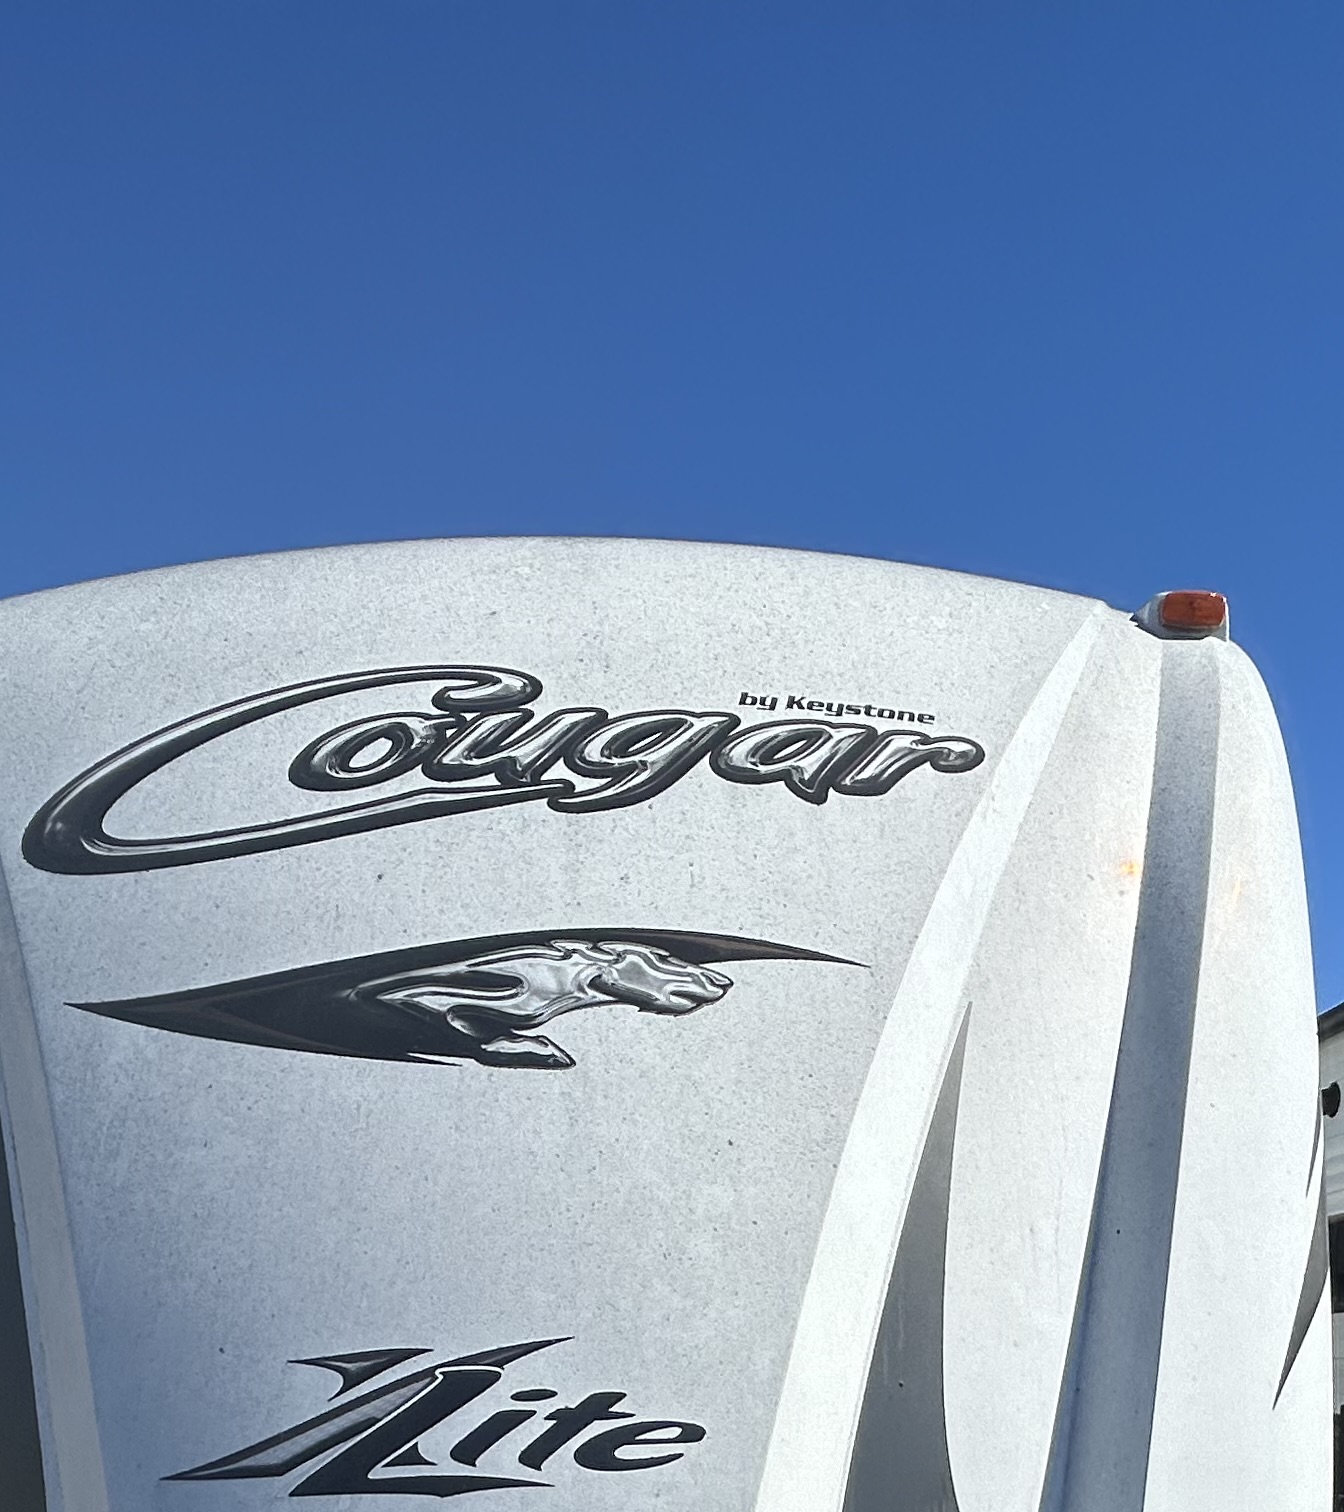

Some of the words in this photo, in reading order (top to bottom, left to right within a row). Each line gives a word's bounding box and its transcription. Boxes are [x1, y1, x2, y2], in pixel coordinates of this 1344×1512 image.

[738, 692, 778, 711] by
[785, 695, 935, 725] Keystone
[22, 665, 985, 875] Cougar
